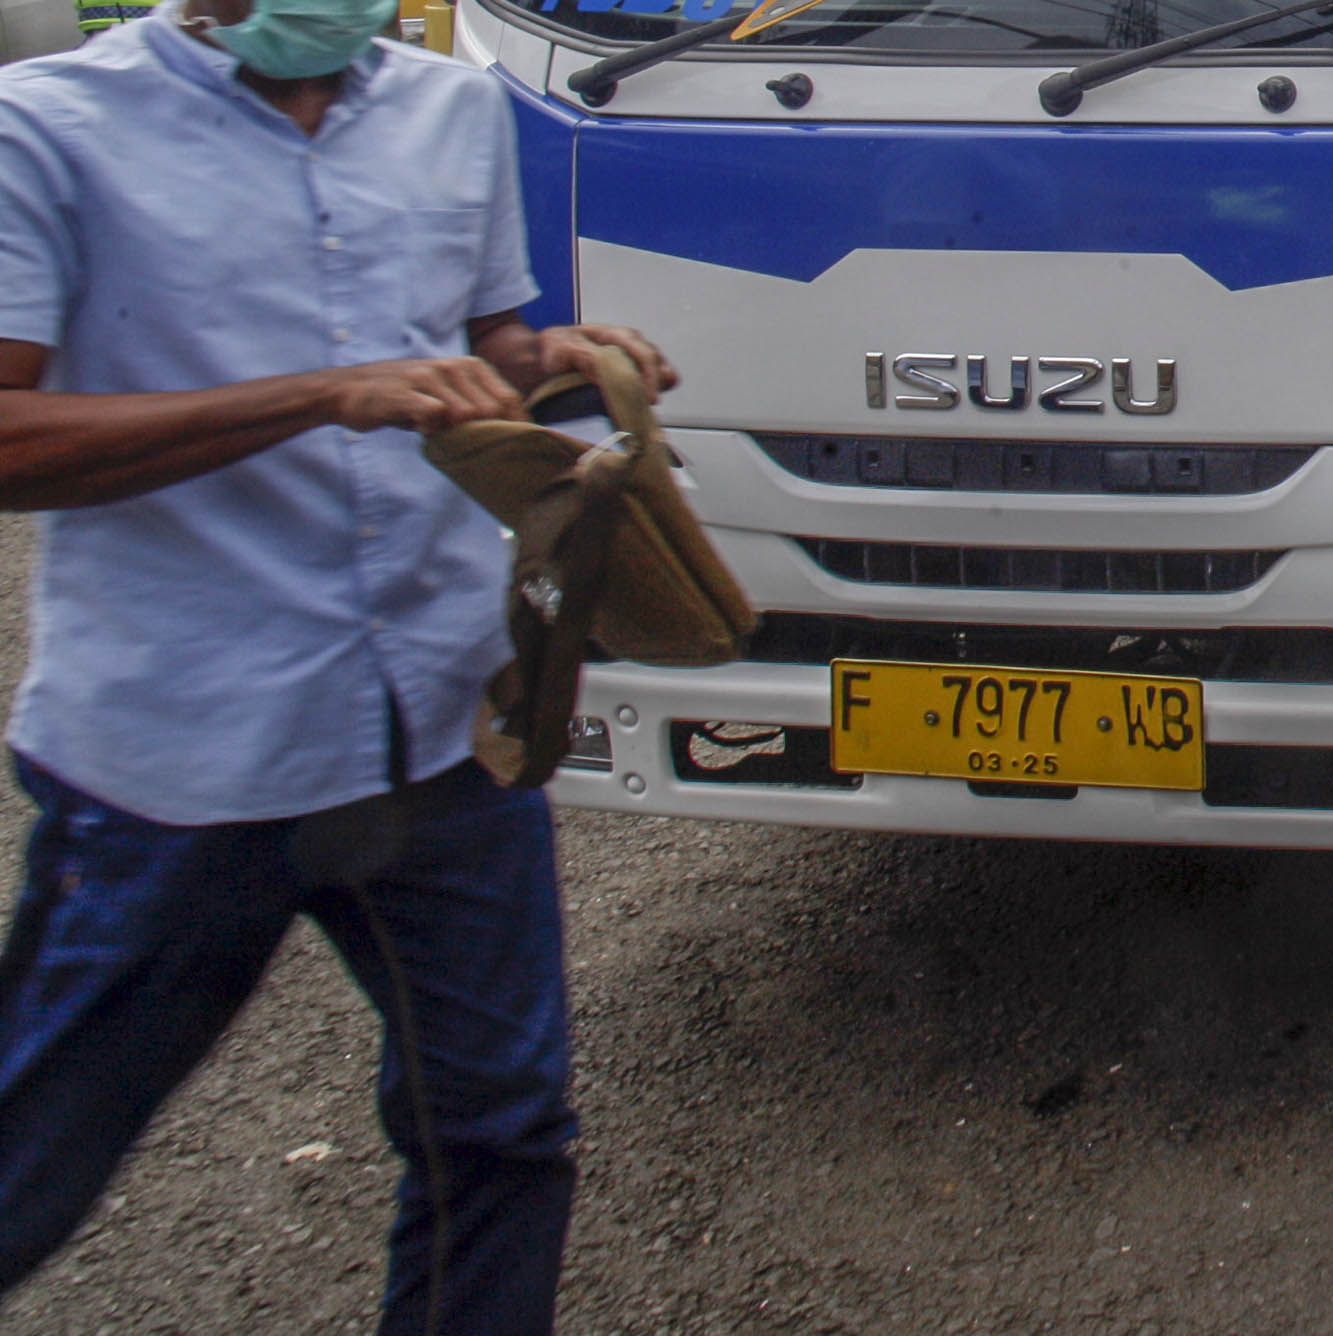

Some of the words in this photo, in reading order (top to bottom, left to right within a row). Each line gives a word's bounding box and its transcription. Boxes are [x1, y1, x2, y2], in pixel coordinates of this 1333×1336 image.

[865, 351, 1178, 415] ISUZU
[841, 671, 871, 732] F
[942, 675, 1072, 744] 7977
